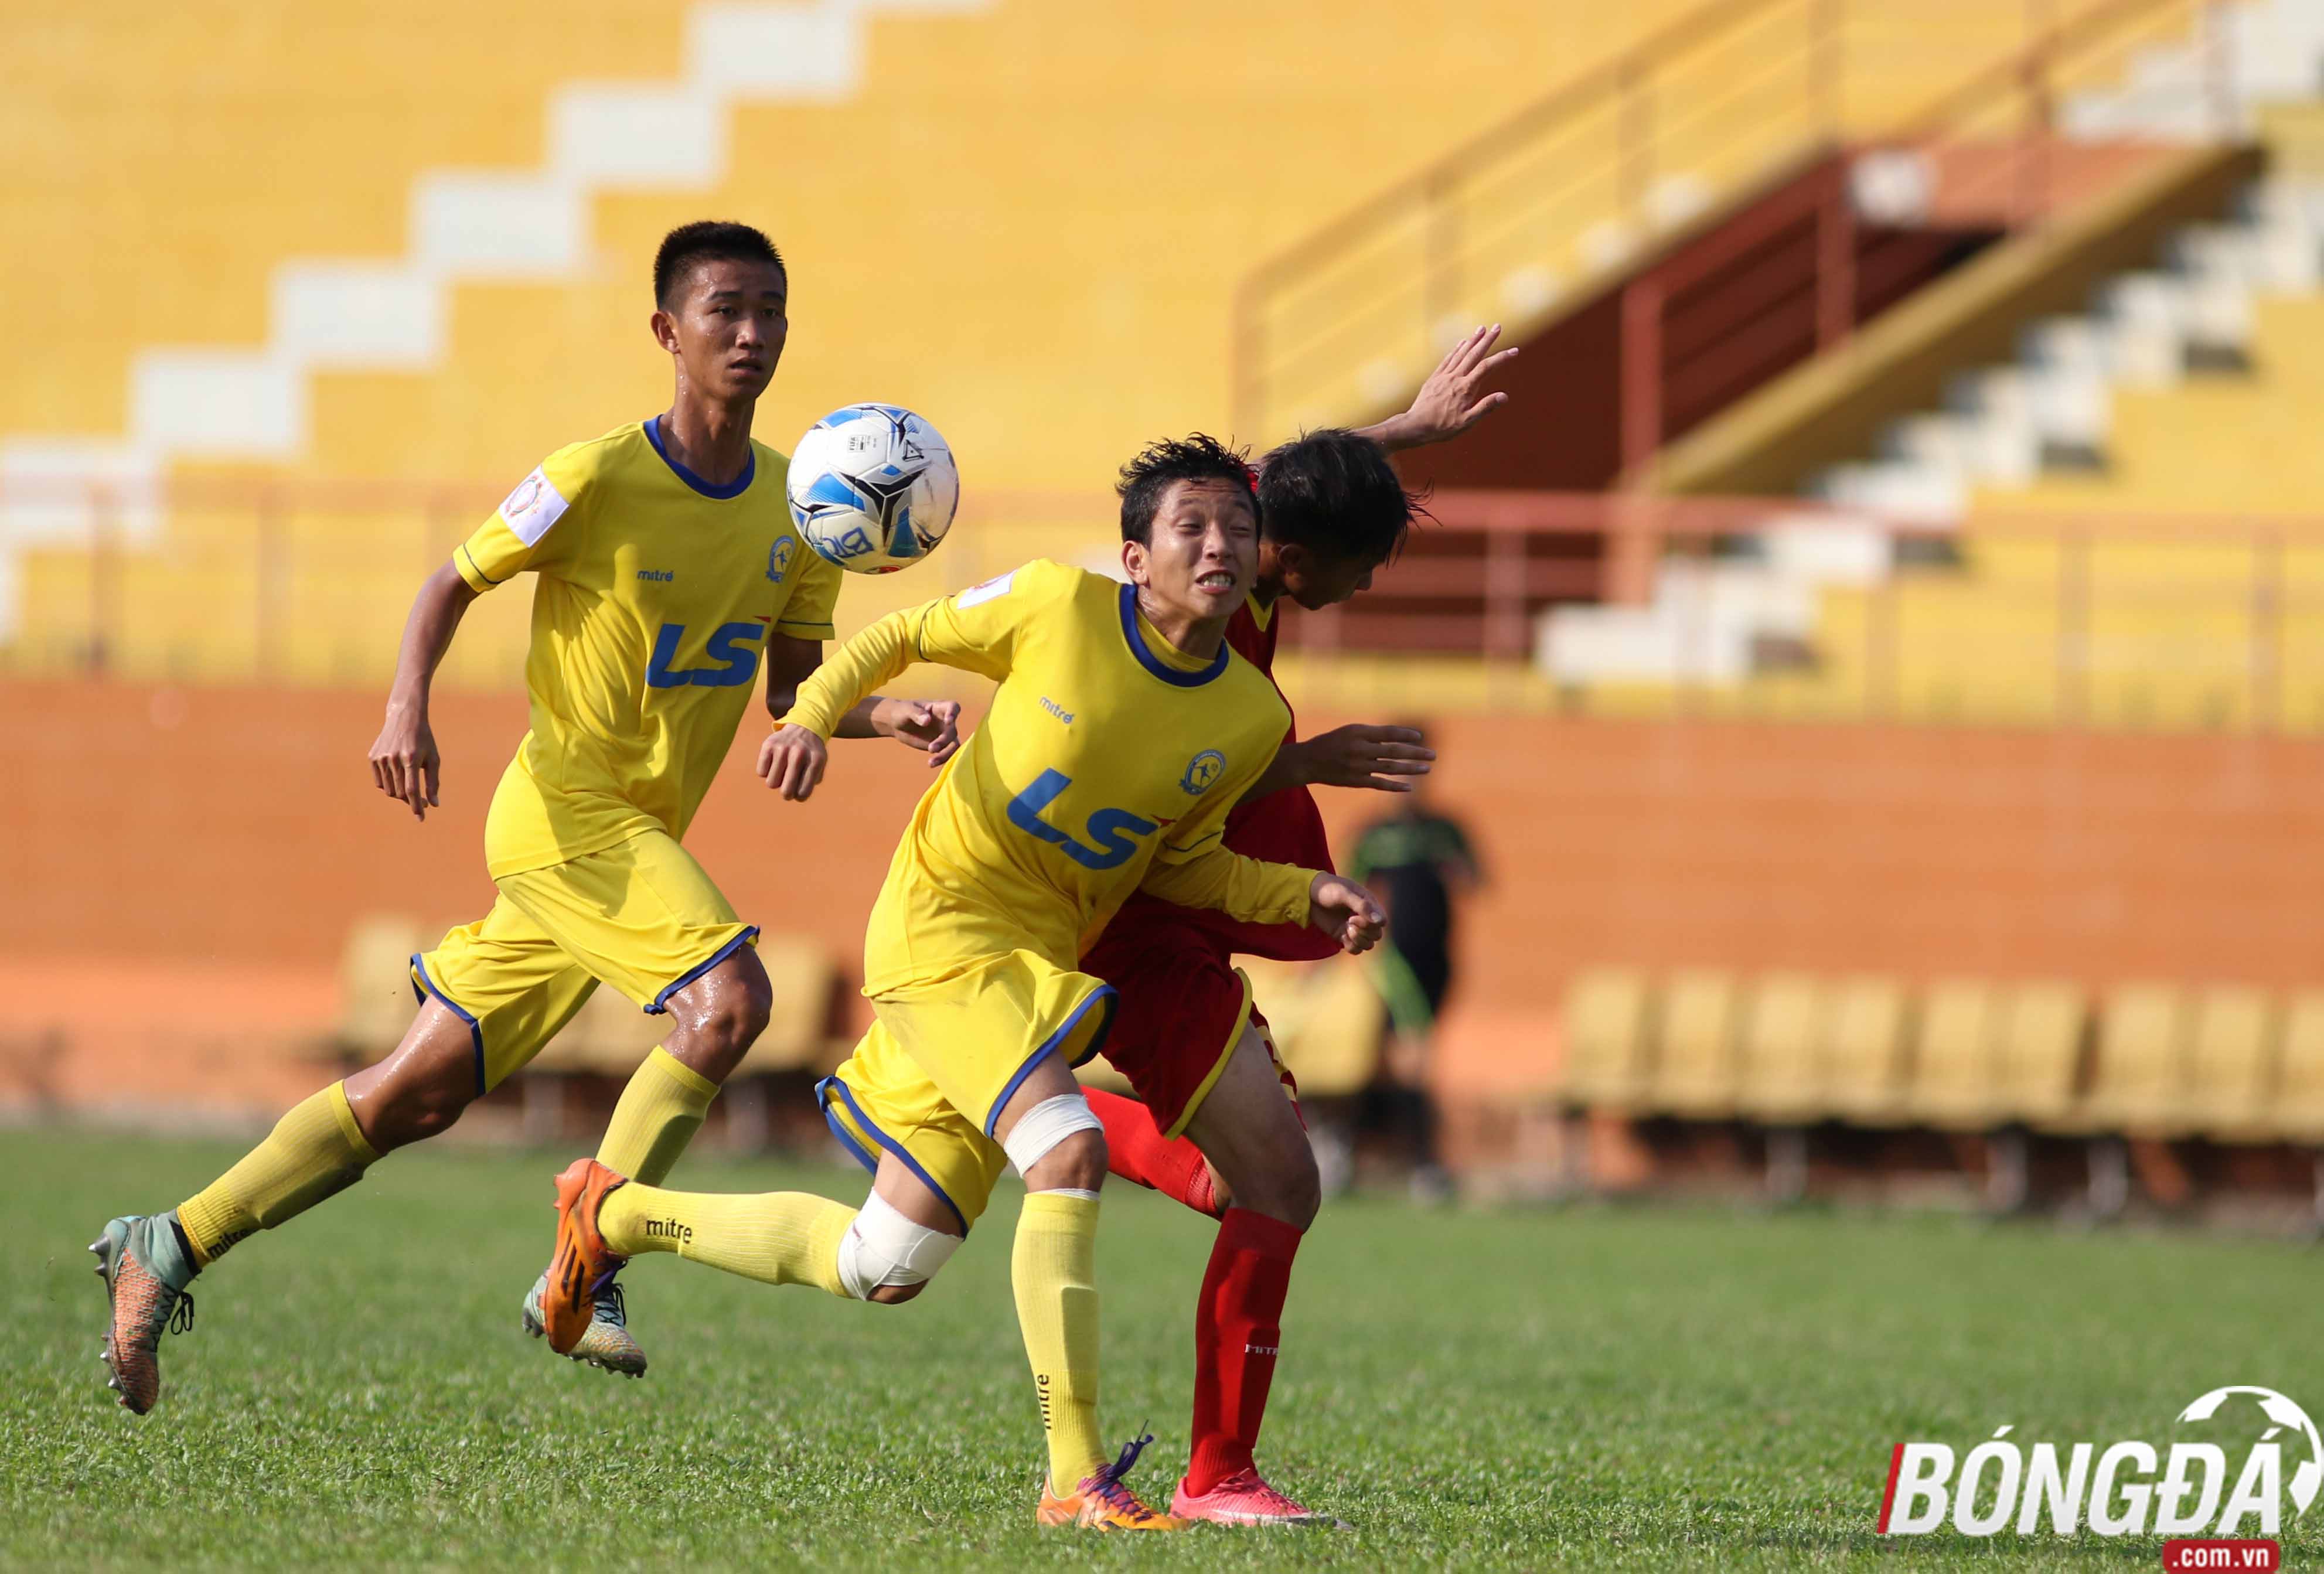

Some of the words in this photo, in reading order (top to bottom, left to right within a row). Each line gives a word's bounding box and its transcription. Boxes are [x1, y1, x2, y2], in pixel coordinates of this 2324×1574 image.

[646, 622, 764, 688] LS
[1006, 767, 1159, 870] LS
[646, 1217, 692, 1244] mitre
